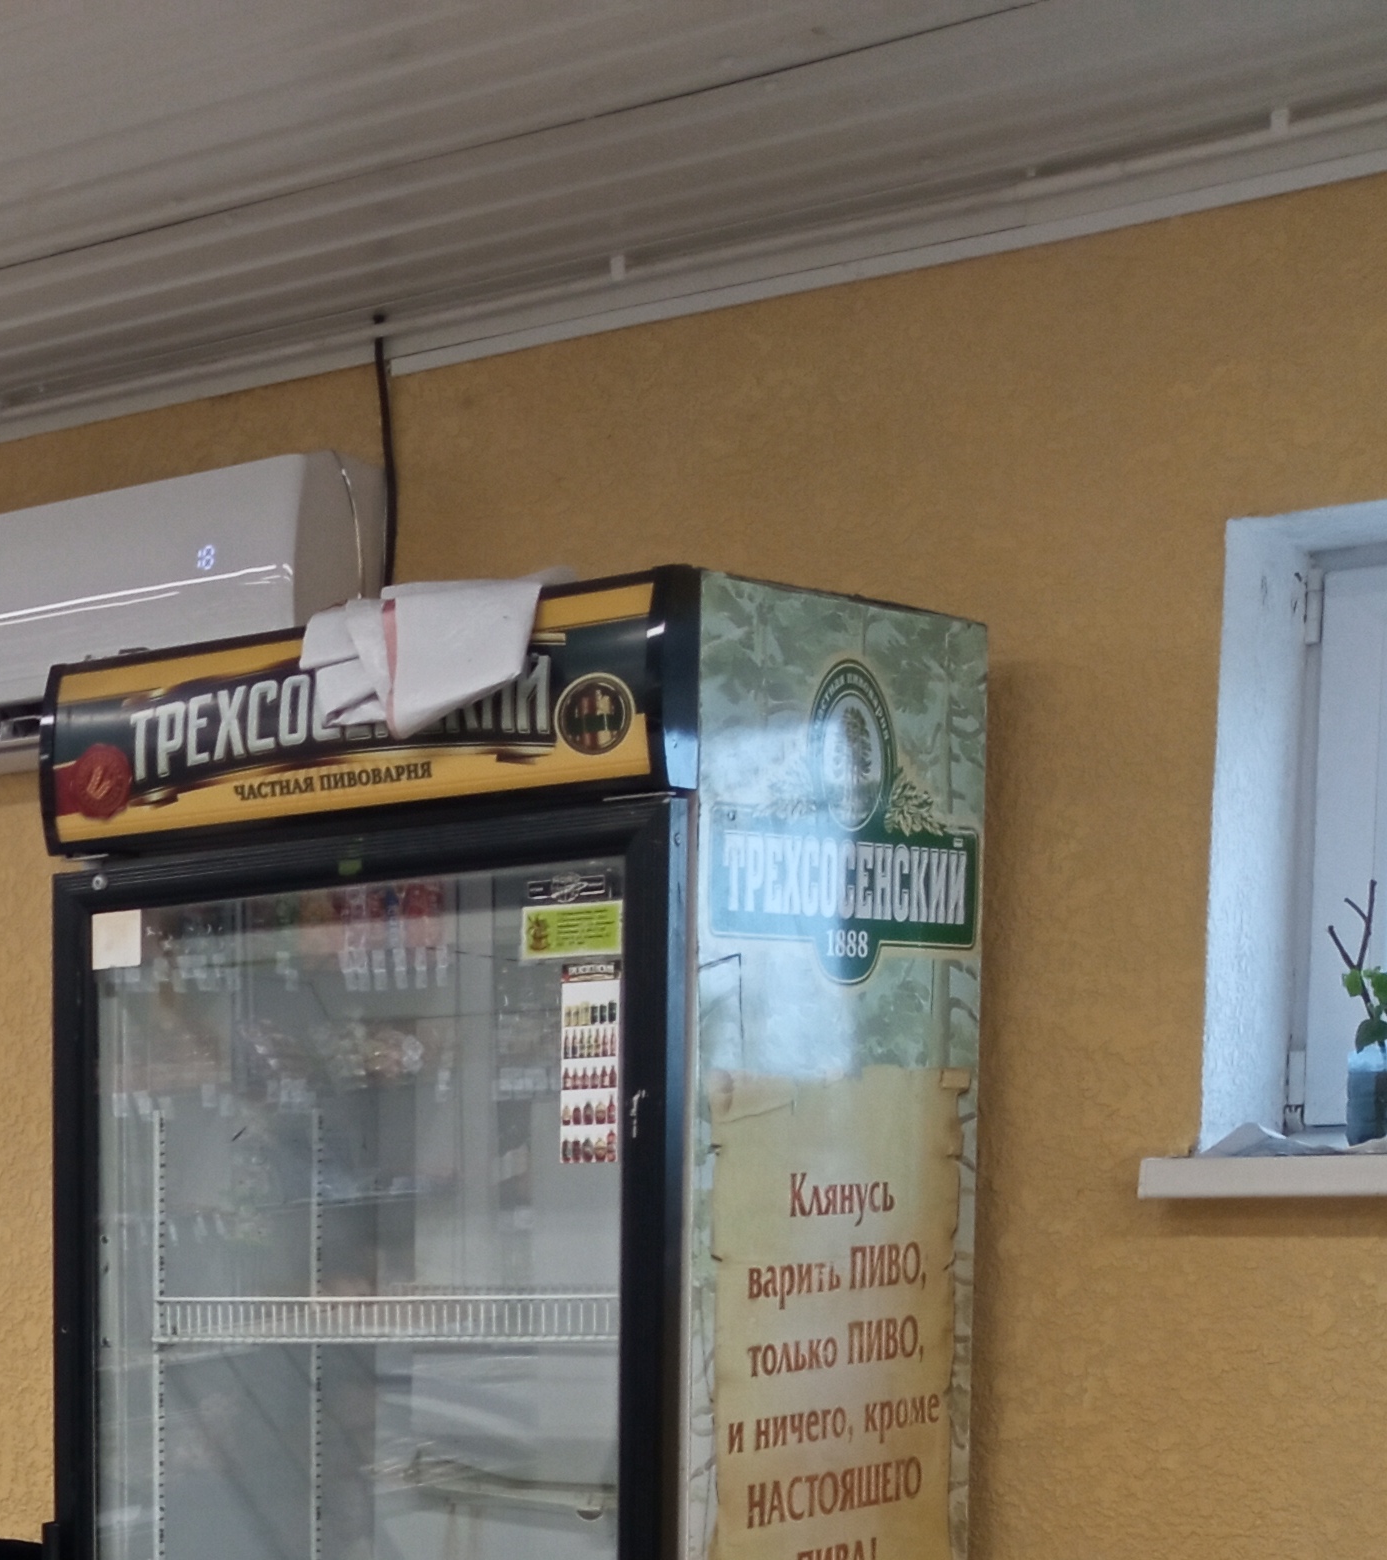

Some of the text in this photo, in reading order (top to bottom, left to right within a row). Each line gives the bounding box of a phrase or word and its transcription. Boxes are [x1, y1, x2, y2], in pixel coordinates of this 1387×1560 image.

[130, 654, 552, 782] ТРЕХСОЙ
[233, 761, 433, 801] ЧАСТНАЯ ПИВОВАРНЯ
[723, 830, 968, 926] ТРЕХСОСЕНСКИЙ
[826, 929, 869, 958] 1888
[788, 1172, 896, 1227] Клянусь
[747, 1241, 927, 1310] варить ПИВО,
[747, 1314, 925, 1378] только ПИВО,
[728, 1392, 941, 1455] и ничего, кроме
[746, 1456, 923, 1530] НАСТОЯЩЕГО
